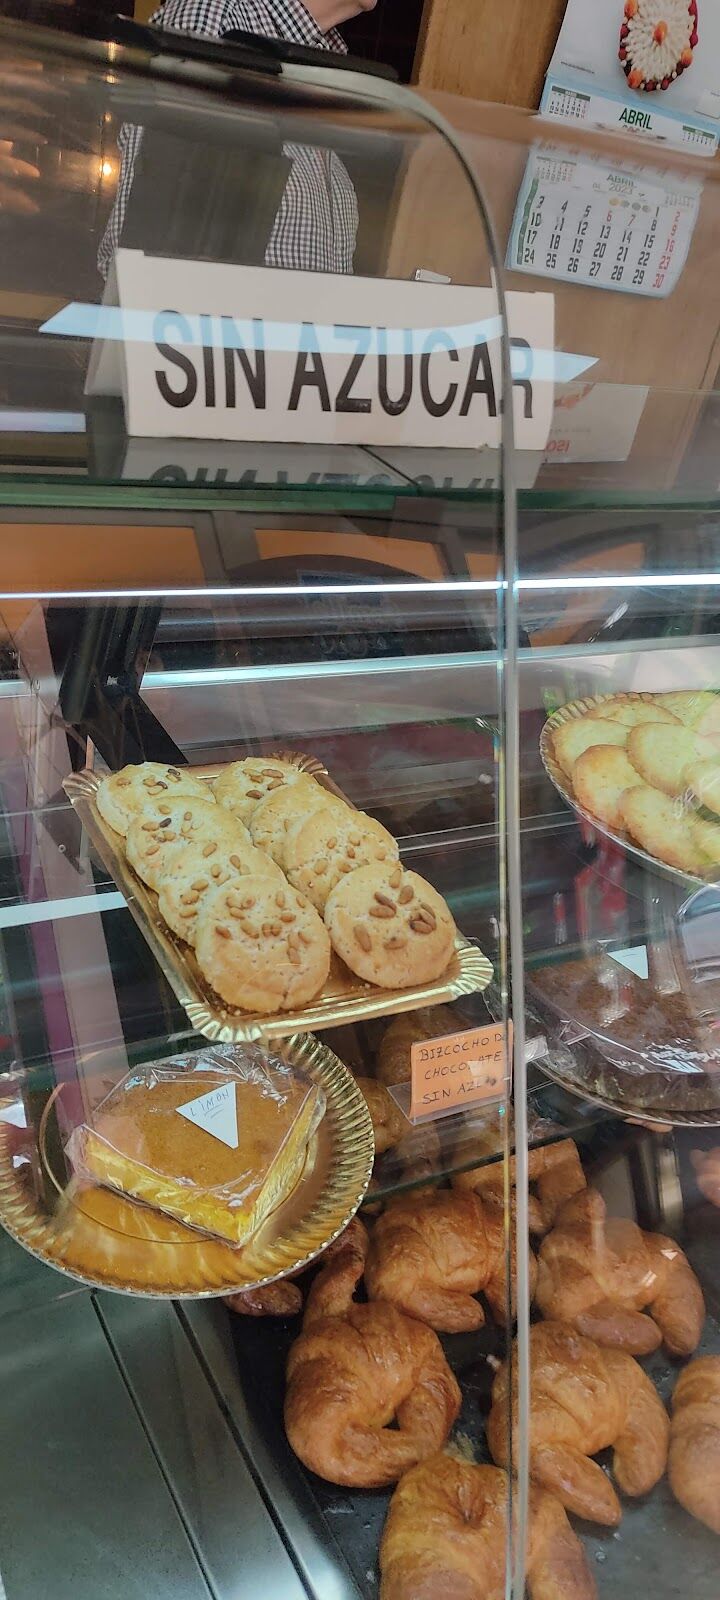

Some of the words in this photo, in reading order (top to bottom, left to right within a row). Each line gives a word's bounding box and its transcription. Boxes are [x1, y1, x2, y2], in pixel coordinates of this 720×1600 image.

[619, 108, 653, 130] ABRIL
[530, 212, 542, 227] 10
[554, 216, 564, 231] 11
[577, 221, 588, 235] 12
[600, 225, 610, 239] 13
[622, 230, 633, 243] 14
[643, 234, 655, 248] 15
[665, 239, 675, 252] 16
[536, 196, 545, 208] 3
[561, 200, 568, 213] 4
[584, 205, 591, 218] 5
[606, 211, 612, 222] 6
[628, 214, 636, 226] 7
[651, 220, 657, 231] 8
[671, 225, 677, 236] 9
[655, 207, 660, 217] 1
[674, 211, 681, 222] 2
[524, 248, 535, 264] 24
[546, 253, 557, 268] 25
[567, 257, 578, 273] 26
[589, 261, 601, 277] 27
[611, 265, 624, 281] 28
[632, 269, 645, 285] 29
[652, 274, 665, 288] 30
[526, 230, 537, 244] 17
[550, 234, 561, 250] 18
[572, 238, 583, 254] 19
[593, 242, 607, 258] 20
[617, 246, 629, 262] 21
[638, 251, 650, 266] 22
[658, 255, 671, 270] 23
[152, 309, 266, 410] SIN
[287, 321, 534, 419] AZUCAR
[419, 1037, 490, 1061] BIZCOCHO
[422, 1089, 451, 1104] SIN
